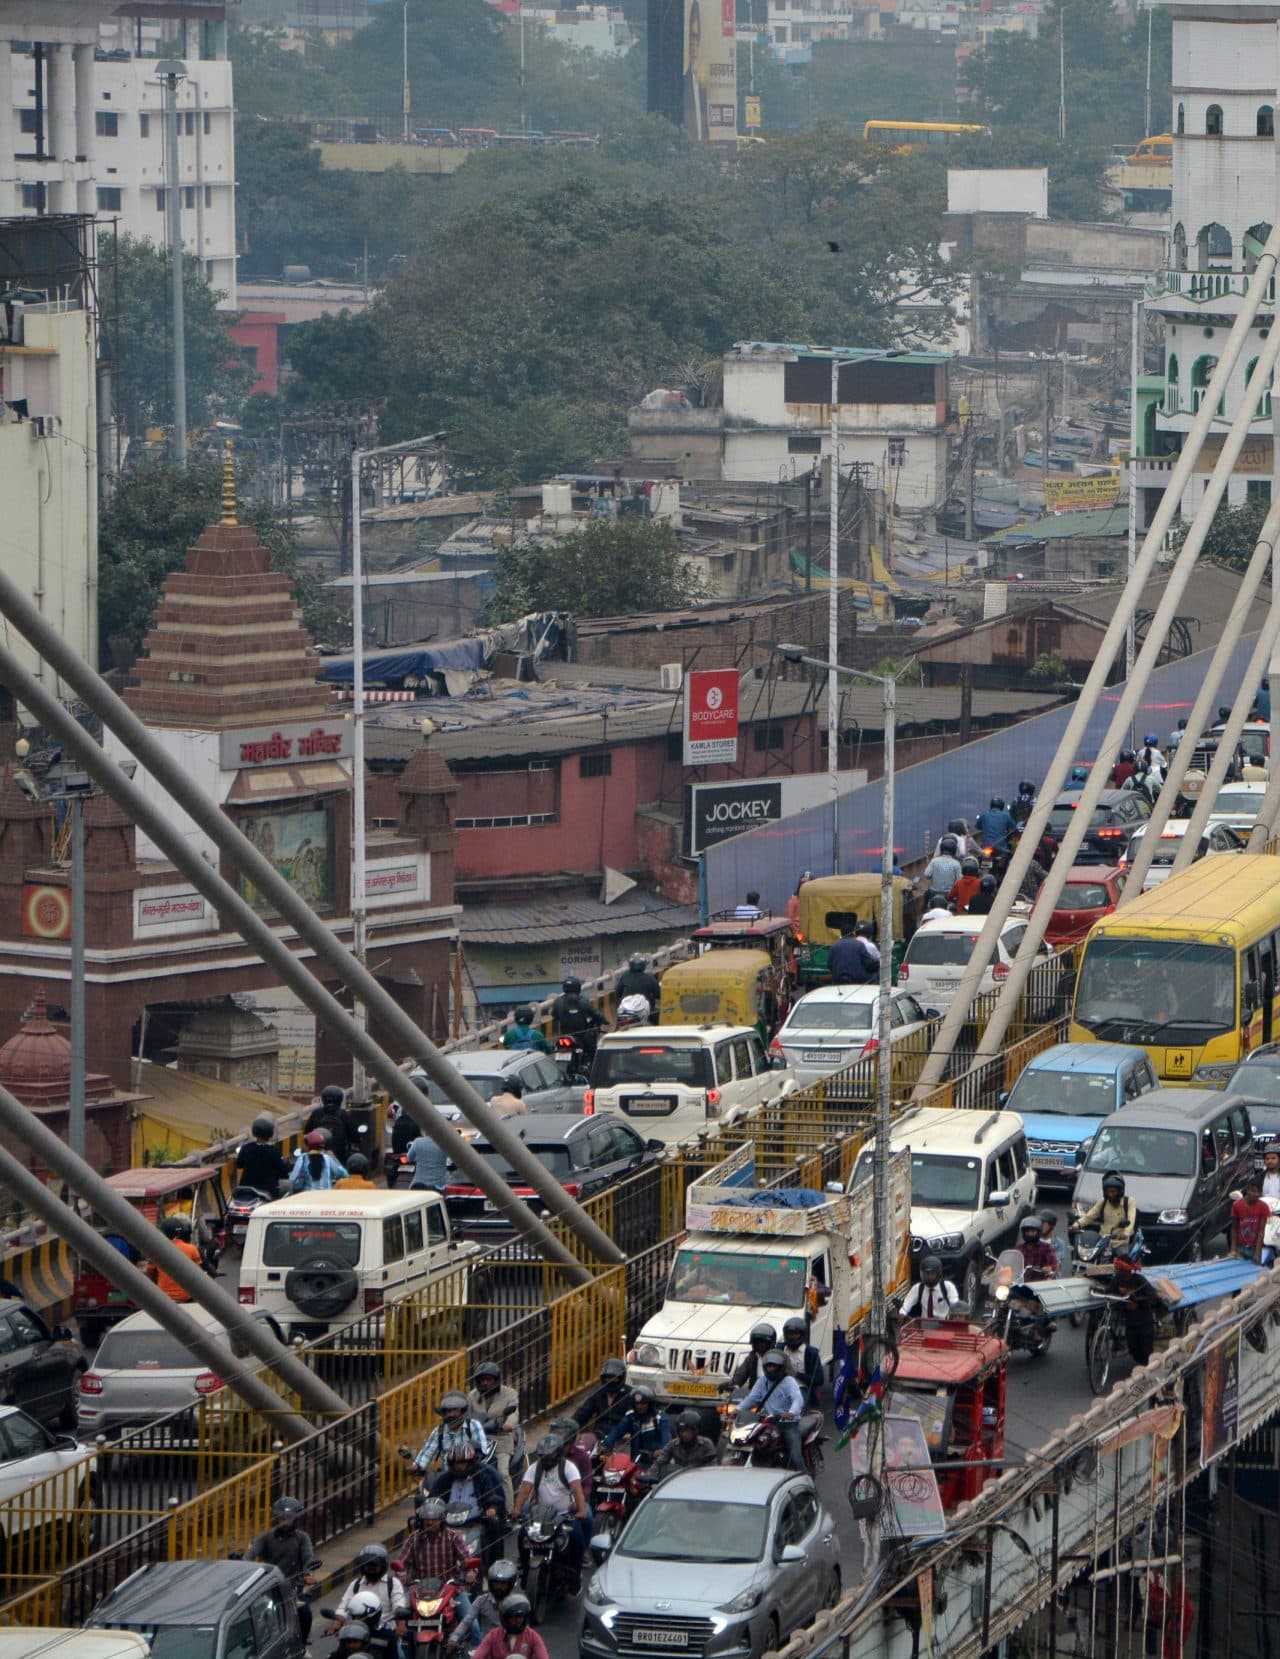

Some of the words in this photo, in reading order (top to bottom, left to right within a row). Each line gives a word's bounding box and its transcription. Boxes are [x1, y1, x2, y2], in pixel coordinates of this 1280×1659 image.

[692, 709, 734, 721] BODYCARE
[240, 731, 294, 763] महावीर
[712, 740, 735, 749] STORES
[705, 799, 771, 822] JOCKEY
[560, 954, 600, 964] CORNER
